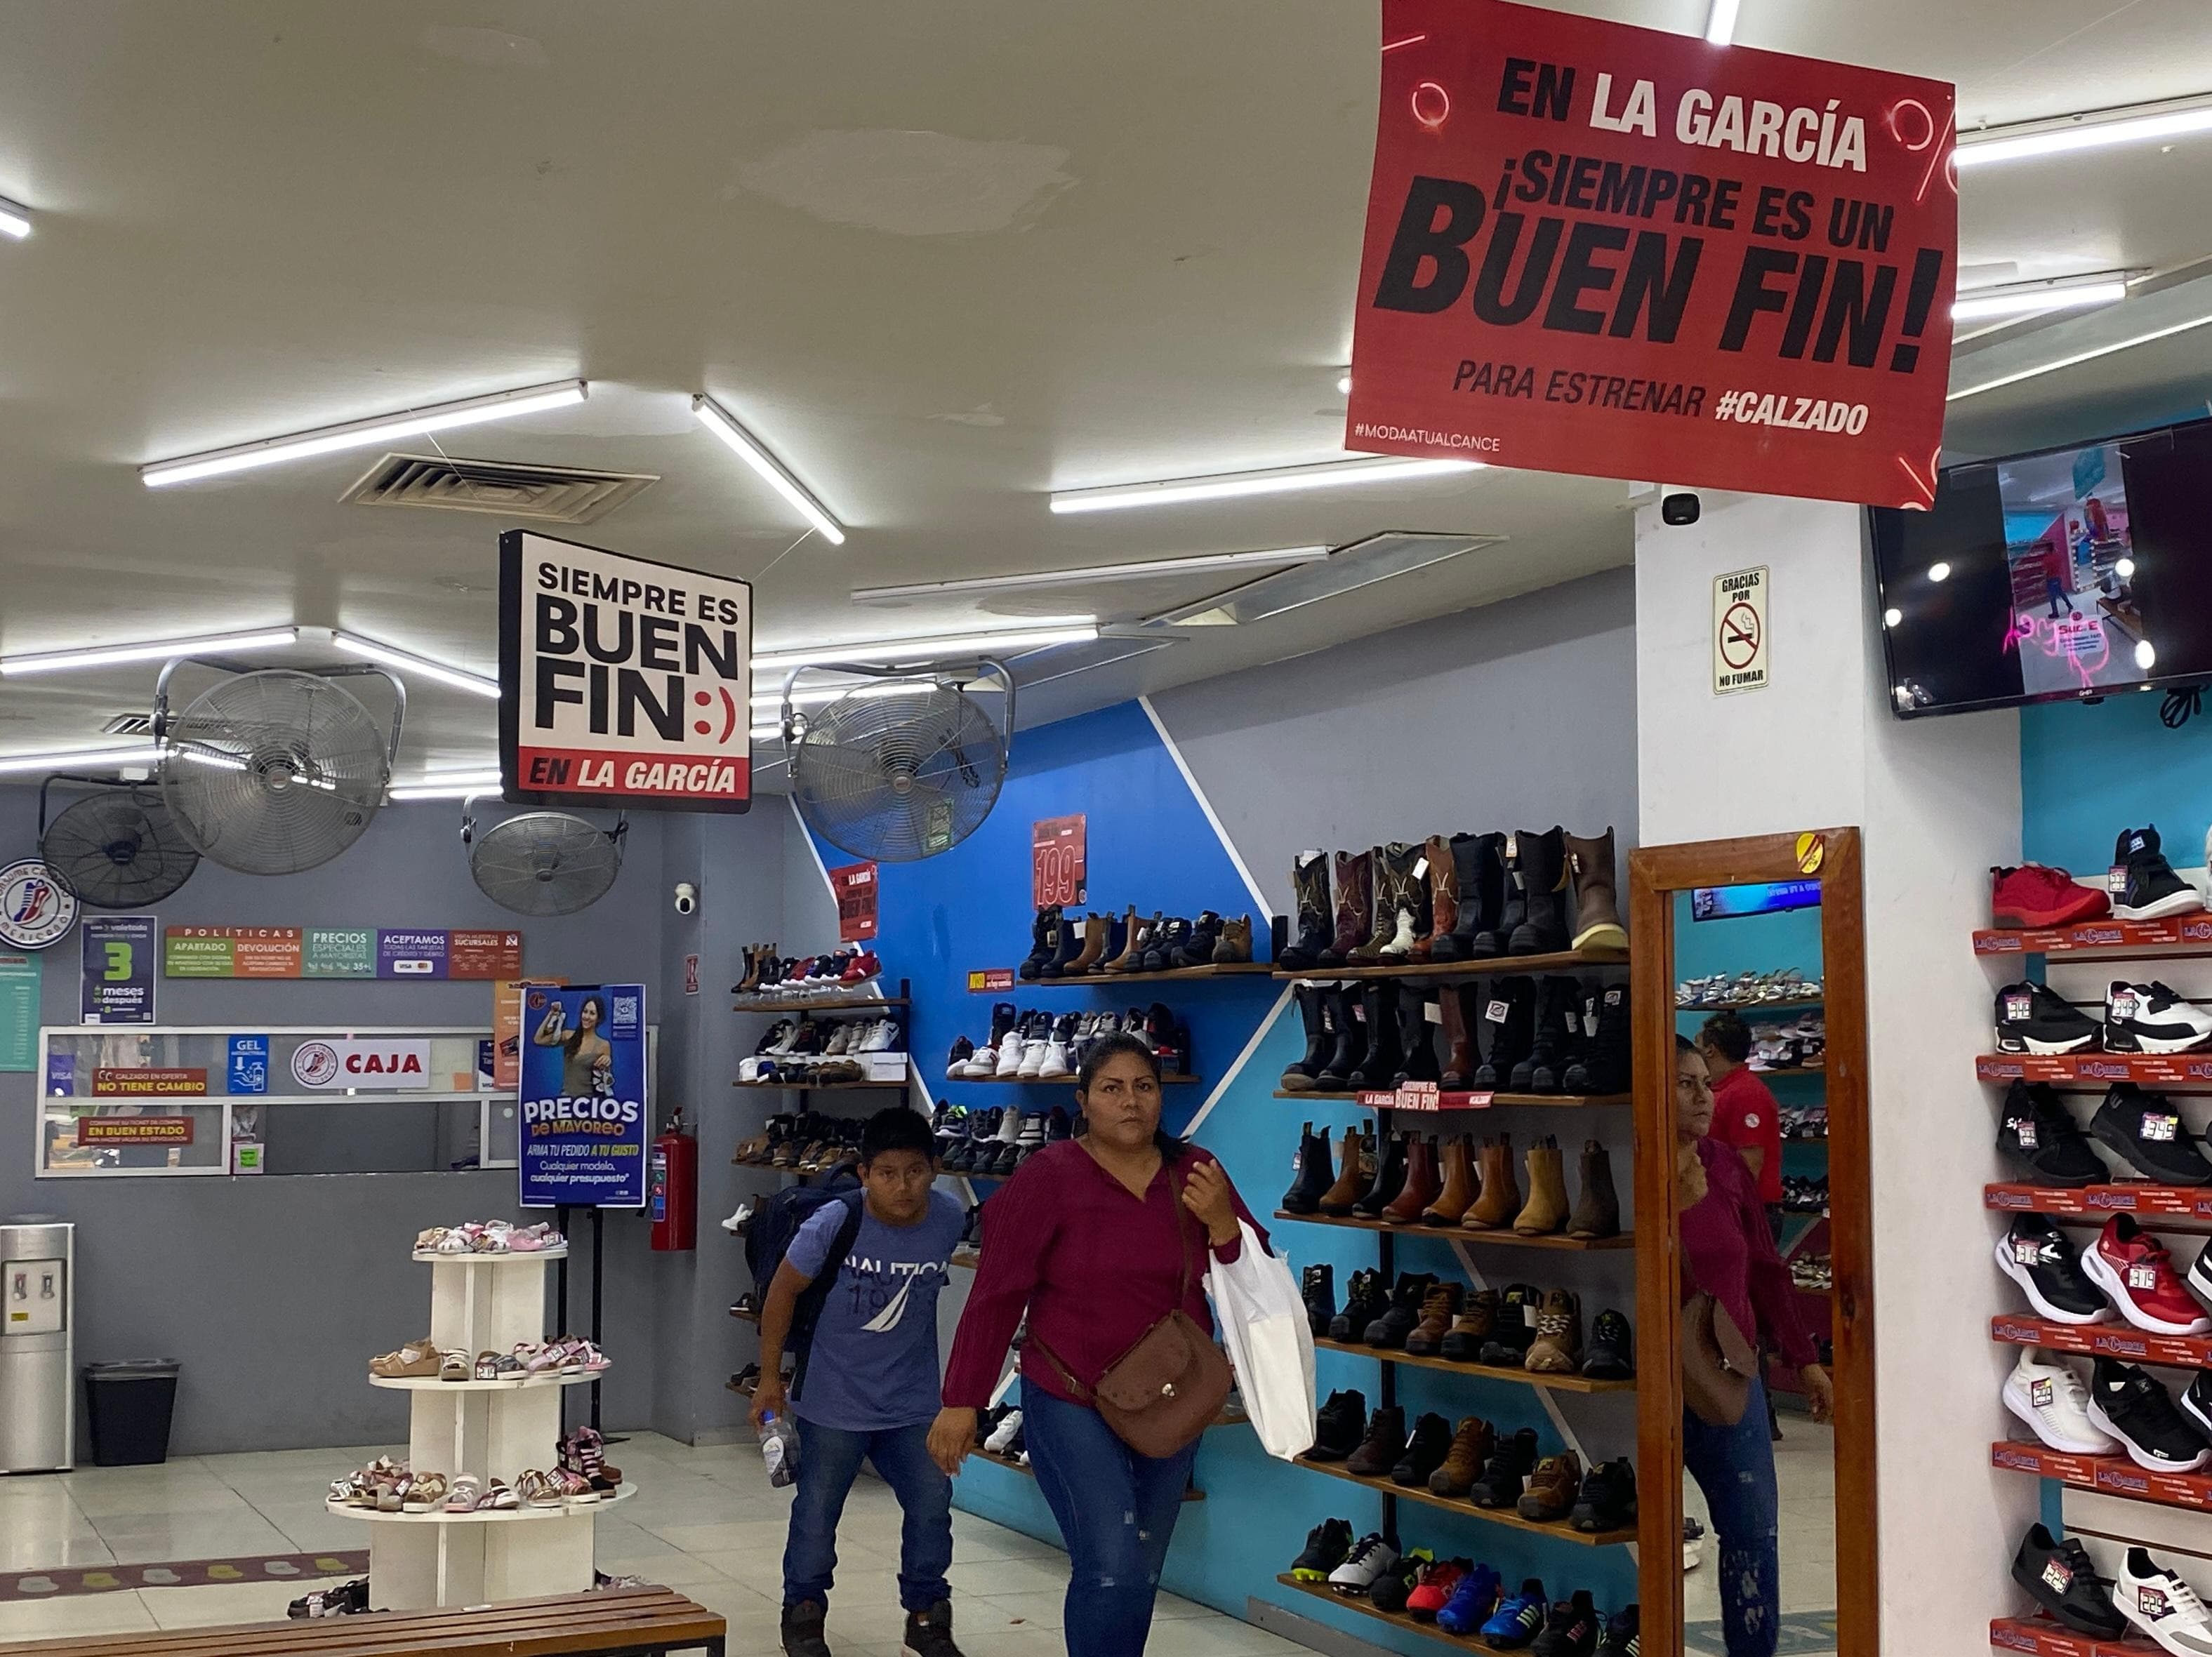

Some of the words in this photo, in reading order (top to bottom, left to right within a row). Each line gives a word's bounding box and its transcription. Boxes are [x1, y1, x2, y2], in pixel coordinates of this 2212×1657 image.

[1496, 56, 1575, 122] EN
[1589, 72, 1657, 137] LA
[1675, 88, 1867, 172] GARCÍA
[1492, 149, 1739, 230] ¡SIEMPRE
[1751, 188, 1815, 241] ES
[1828, 198, 1894, 252] UN
[1372, 175, 1704, 345] BUEN
[1717, 246, 1944, 374] FIN!
[1452, 359, 1534, 399] PARA
[1544, 369, 1707, 418] ESTRENAR
[1715, 390, 1869, 437] #CALZADO
[1354, 422, 1502, 453] #MODAATUALCANCE
[1722, 573, 1759, 592] GRACIAS
[538, 562, 686, 616] SIEMPRE
[698, 594, 739, 625] ES
[1732, 590, 1750, 603] POR
[536, 592, 739, 681] BUEN
[1719, 674, 1730, 687] NO
[1732, 670, 1763, 686] FUMAR
[529, 757, 571, 785] EN
[577, 759, 615, 787] LA
[625, 758, 736, 793] GARCÍA
[185, 927, 293, 938] POLÍTICAS
[312, 933, 366, 943] PRECIOS
[383, 936, 445, 944] ACEPTAMOS
[174, 943, 226, 951] APARTADO
[237, 943, 300, 952] DEVOLUCIÓN
[312, 943, 366, 952] ESPECIALES
[104, 942, 132, 980] 3
[102, 987, 144, 996] meses
[102, 994, 143, 1004] después
[237, 1040, 262, 1050] GEL
[345, 1054, 422, 1074] CAJA
[98, 1082, 117, 1091] NO
[119, 1082, 154, 1091] TIENE
[156, 1082, 205, 1091] CAMBIO
[524, 1097, 639, 1123] PRECIOS
[88, 1127, 103, 1136] EN
[106, 1126, 136, 1136] BUEN
[139, 1126, 185, 1135] ESTADO
[526, 1145, 548, 1156] ARMA
[550, 1145, 560, 1156] TU
[561, 1145, 590, 1156] PEDIDO
[590, 1145, 597, 1156] A
[599, 1145, 609, 1156] TU
[611, 1145, 639, 1156] GUSTO
[540, 1160, 578, 1172] Cualquier
[530, 1173, 569, 1185] cualquier
